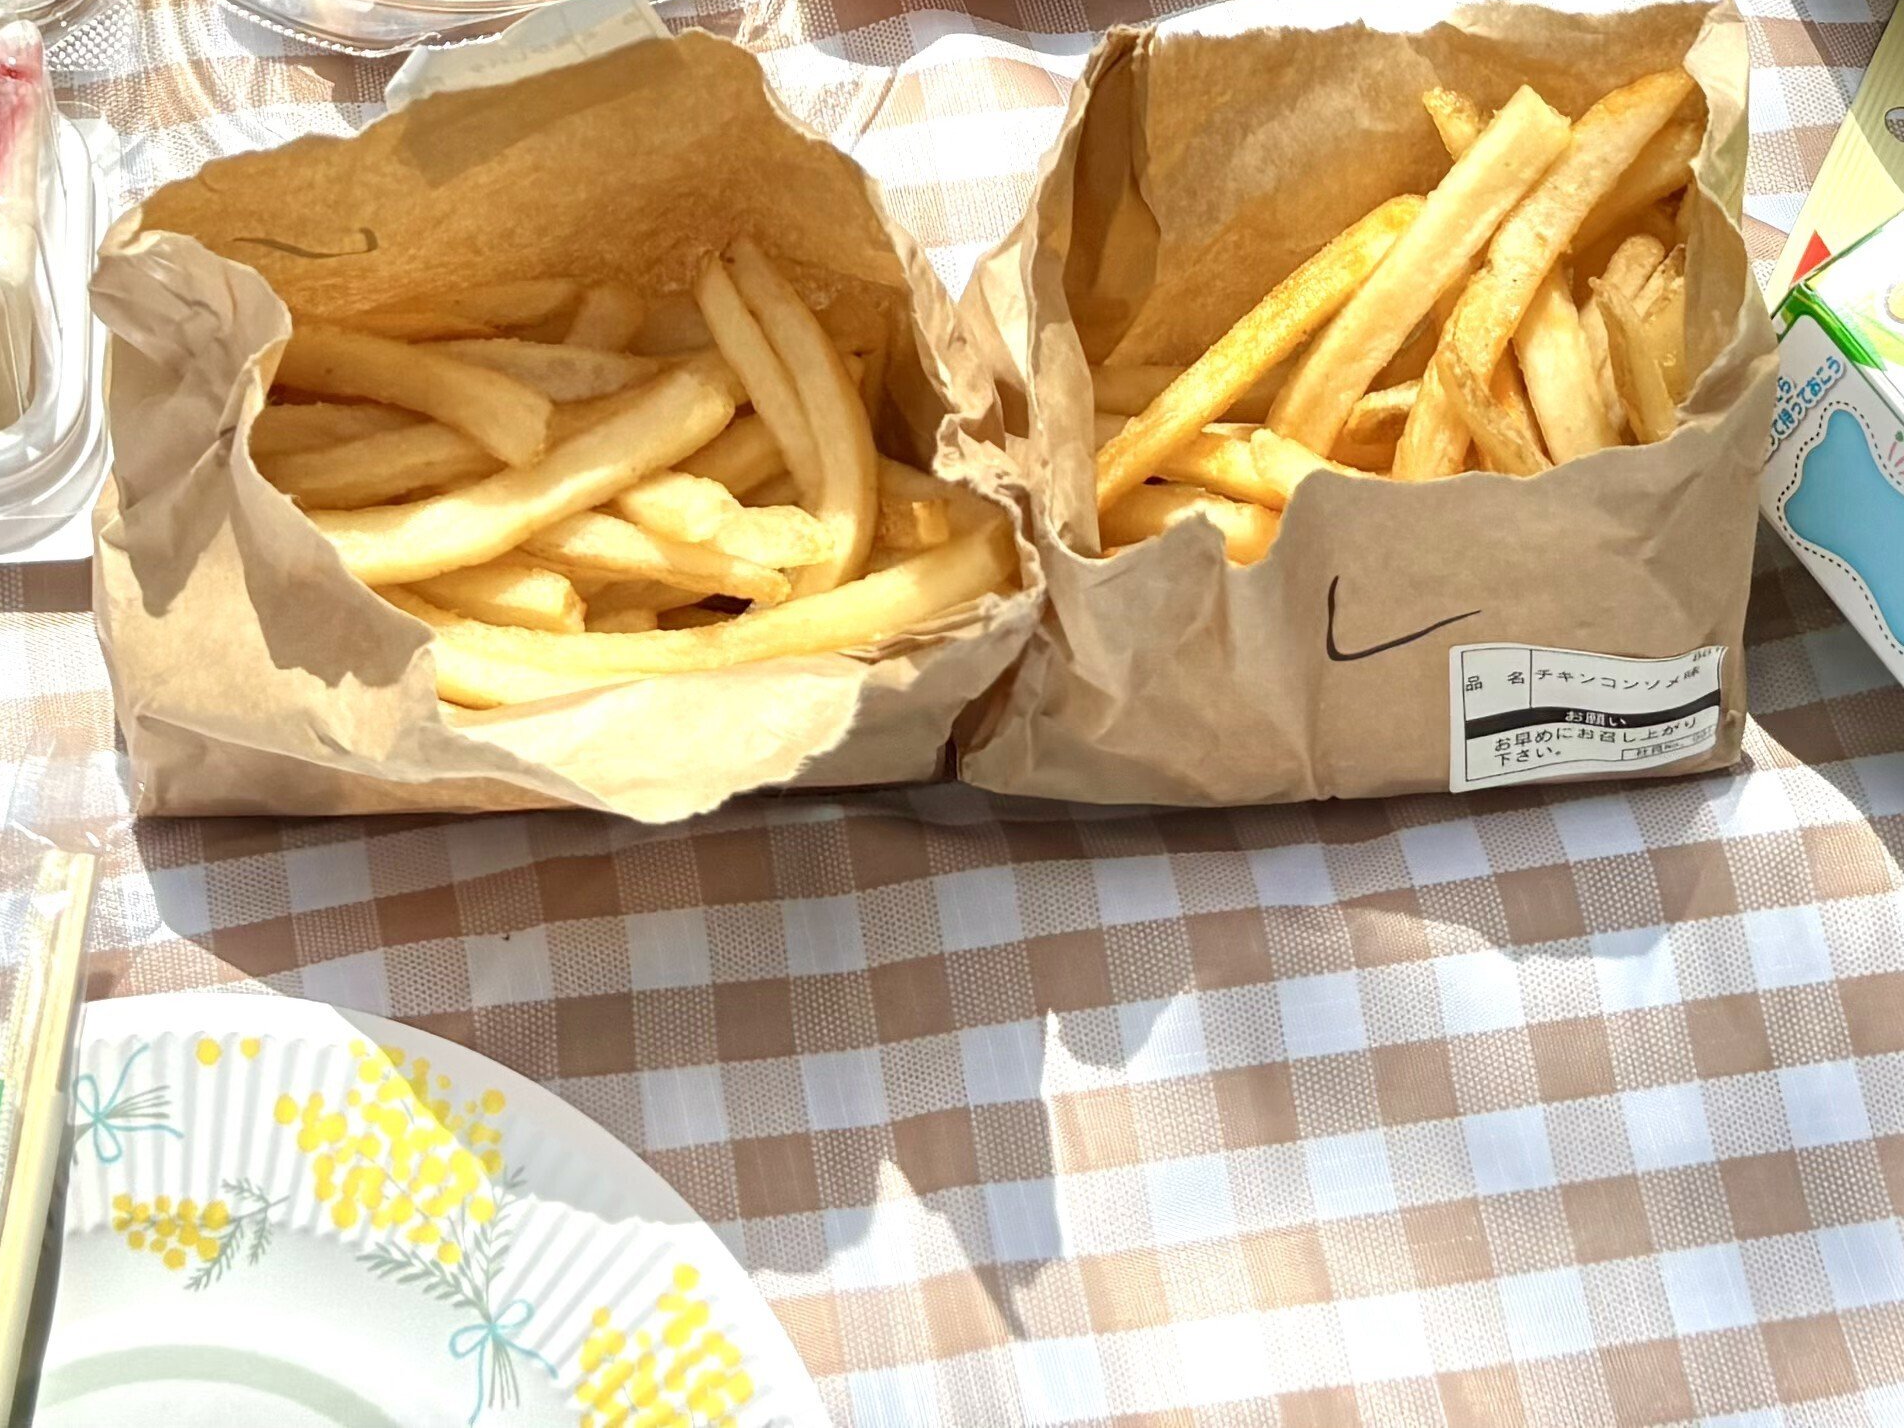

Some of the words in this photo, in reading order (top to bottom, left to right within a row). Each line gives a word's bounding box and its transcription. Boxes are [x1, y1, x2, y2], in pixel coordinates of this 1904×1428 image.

[1564, 709, 1628, 727] お願い
[1494, 717, 1697, 752] お早めにお召し上がり
[1494, 746, 1563, 768] 下さい。
